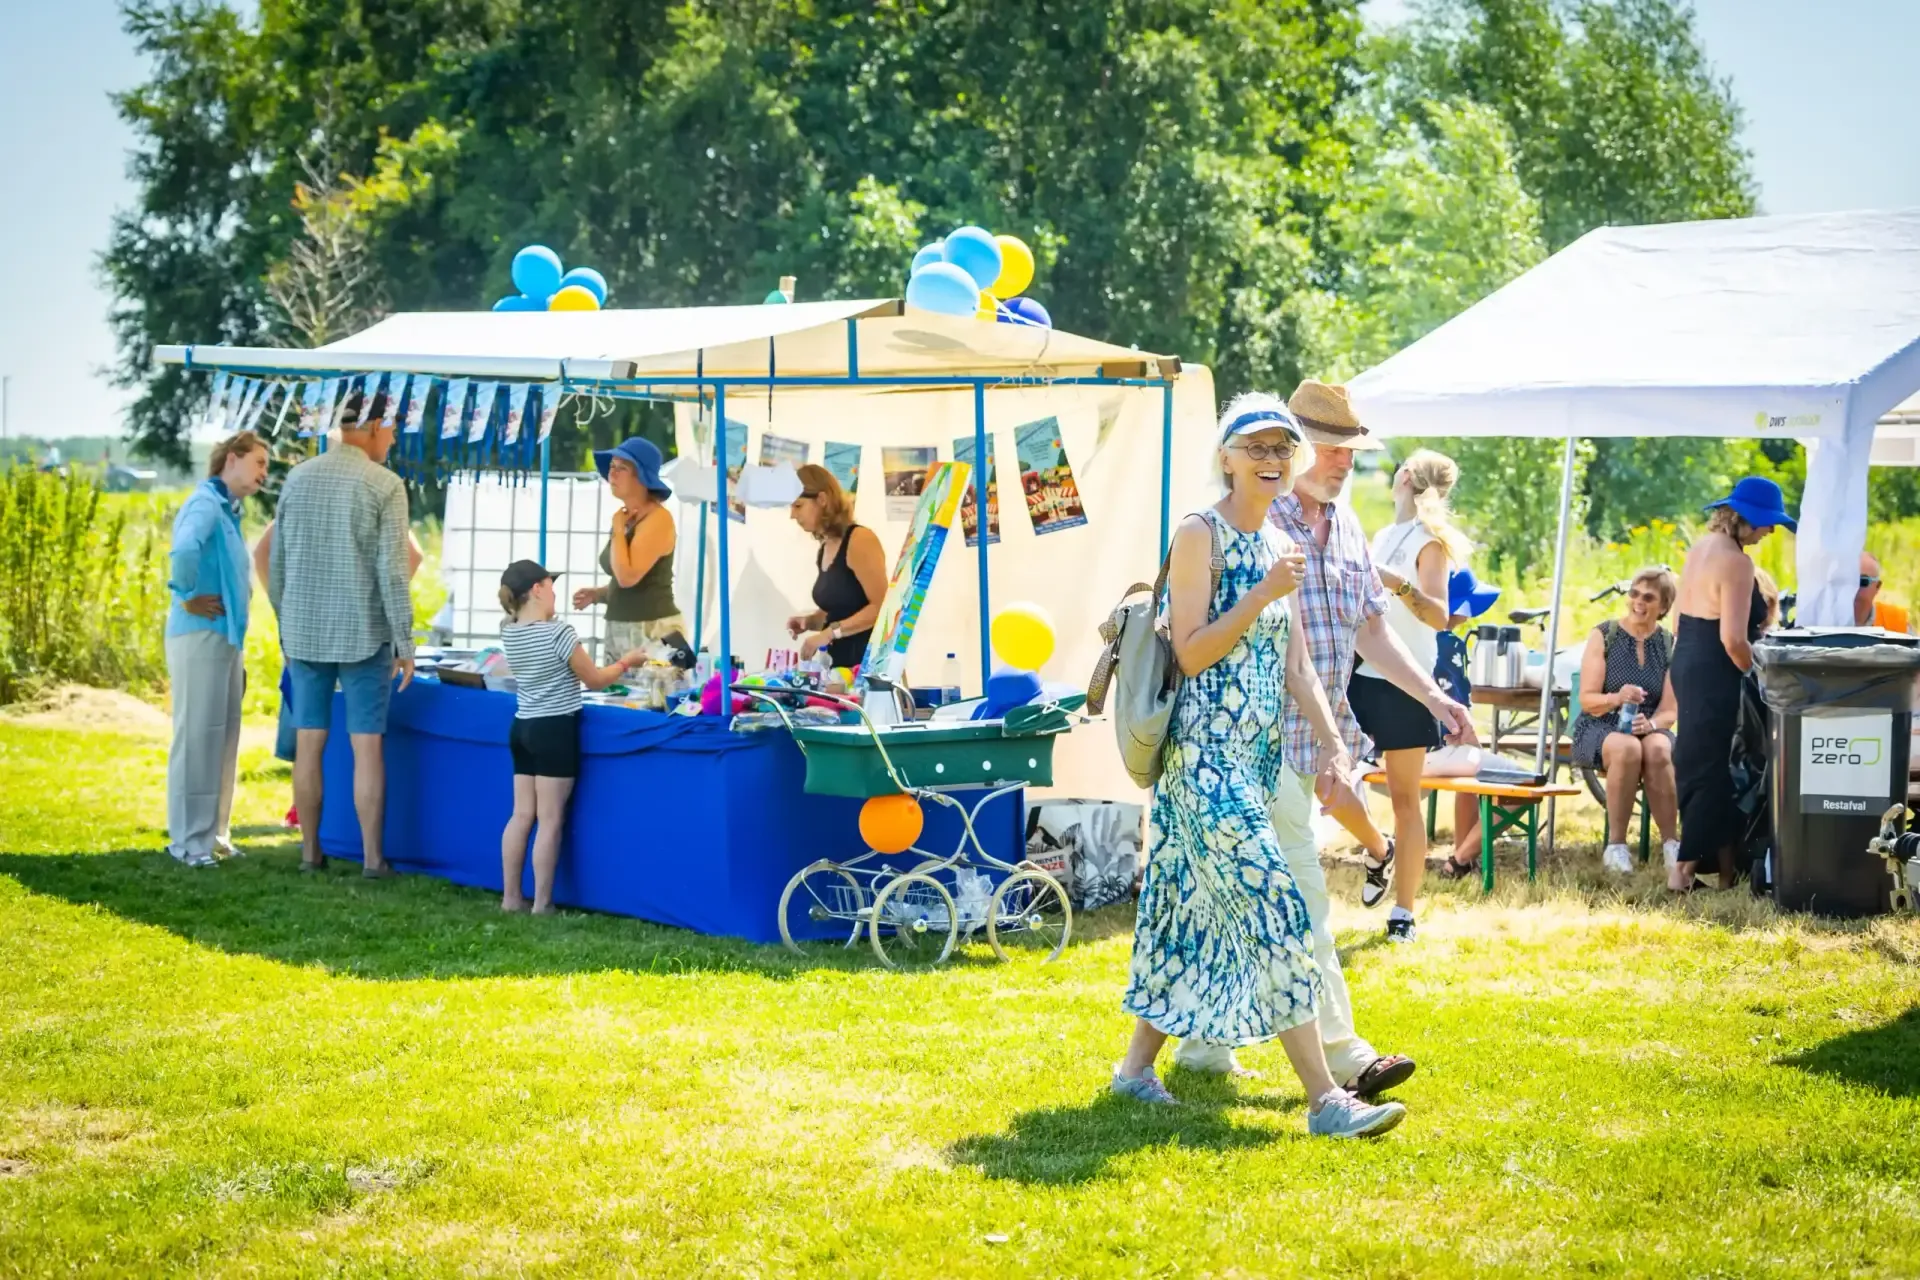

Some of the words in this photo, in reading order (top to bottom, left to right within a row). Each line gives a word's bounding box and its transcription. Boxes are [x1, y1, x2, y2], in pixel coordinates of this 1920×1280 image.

[1769, 416, 1787, 428] DWS
[1811, 737, 1848, 751] pre
[1811, 753, 1861, 765] zero
[1823, 800, 1866, 811] Restafval
